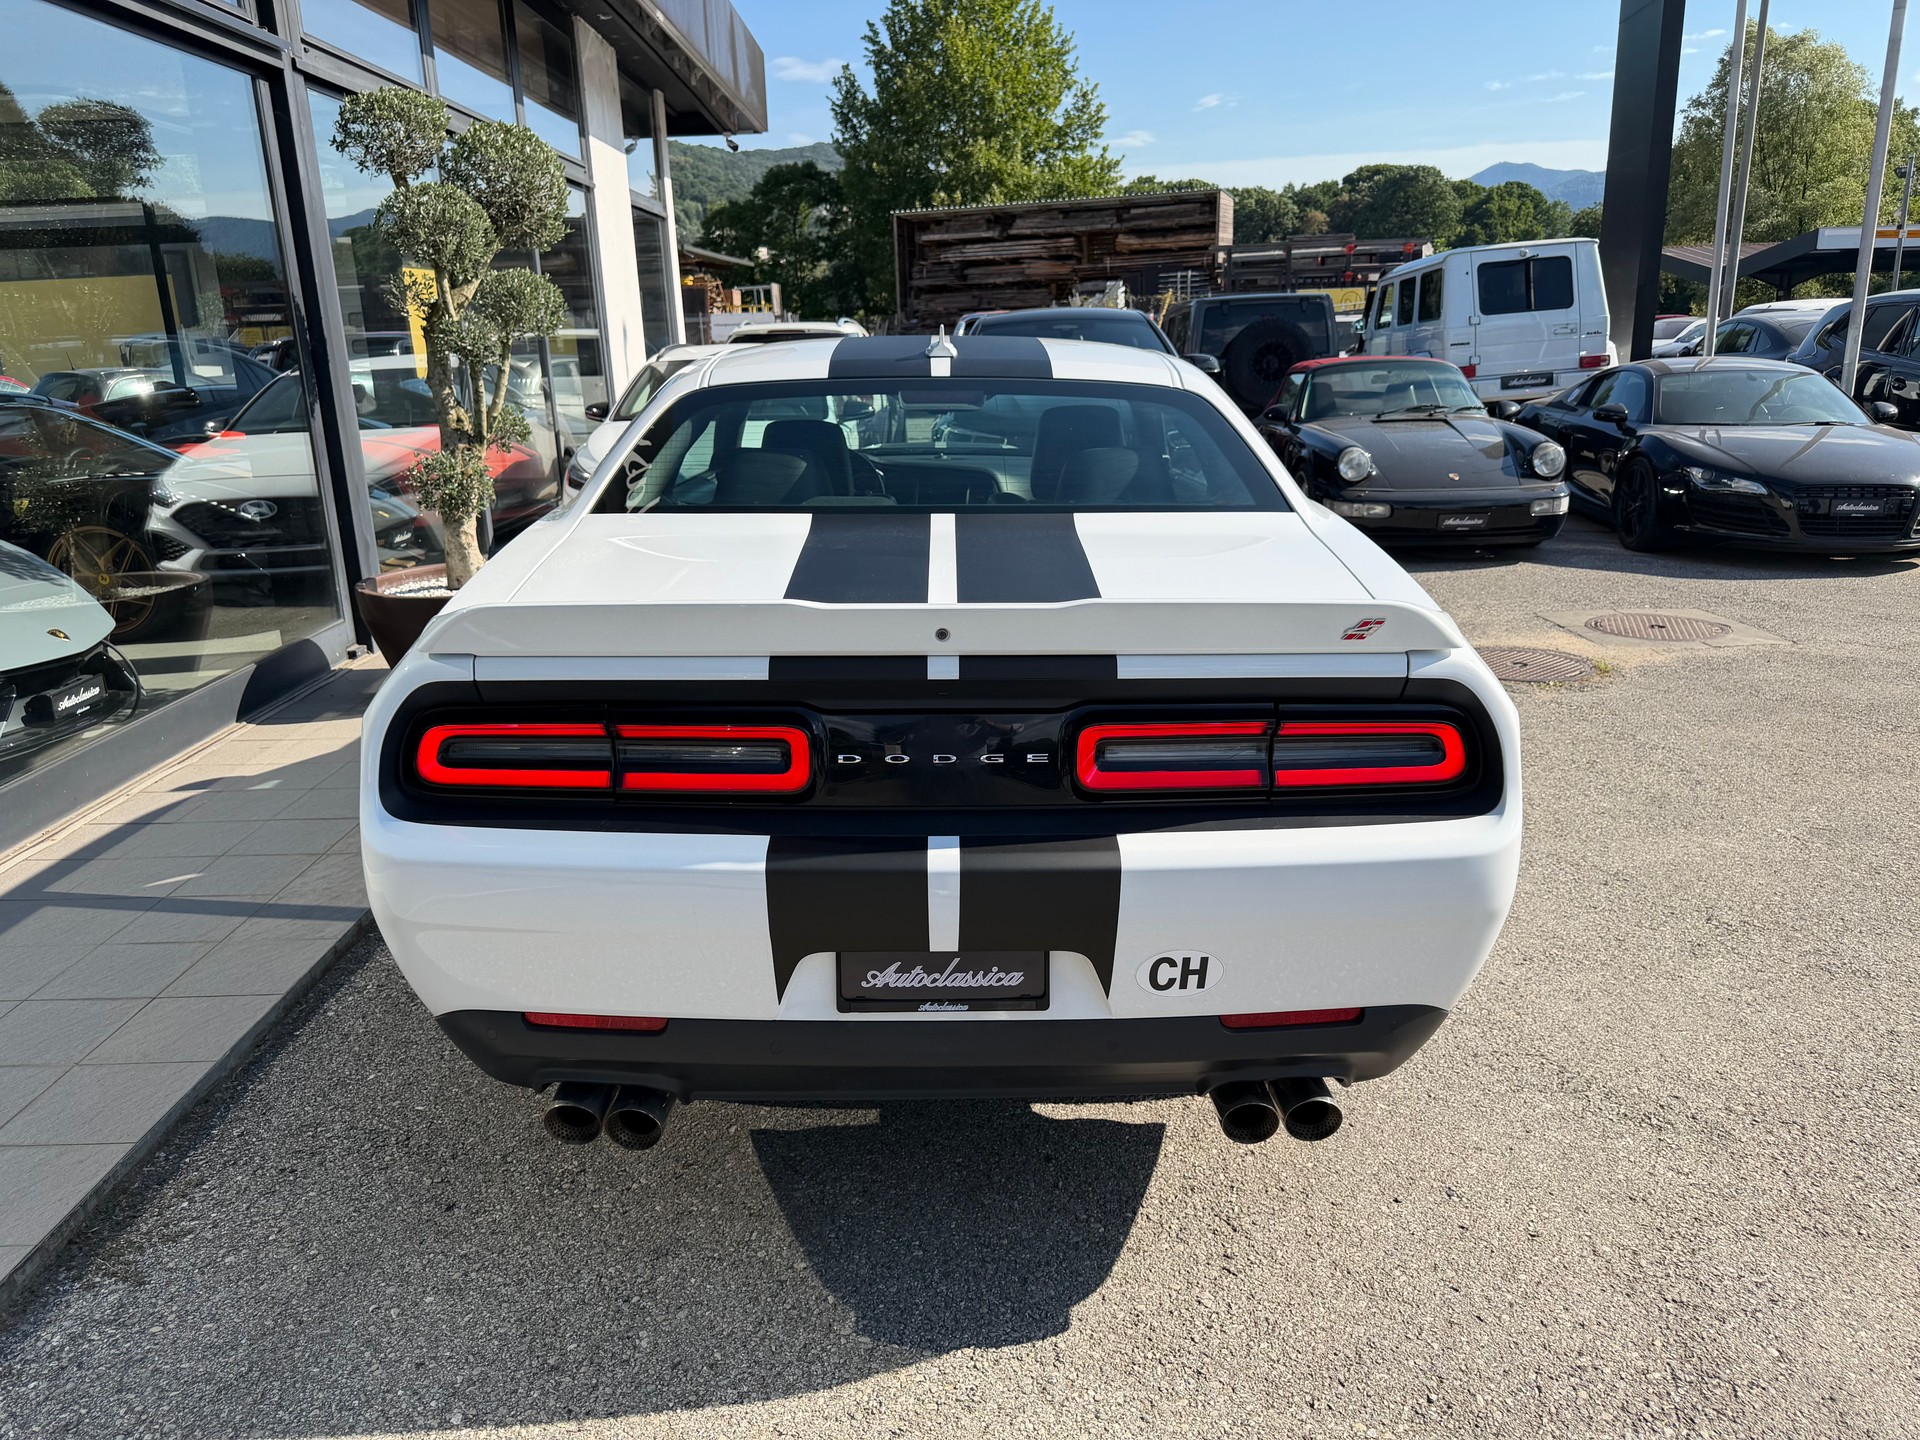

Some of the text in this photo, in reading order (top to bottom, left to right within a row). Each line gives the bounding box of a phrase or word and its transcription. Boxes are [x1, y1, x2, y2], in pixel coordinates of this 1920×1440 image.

[57, 686, 101, 711] Autoclassica
[837, 753, 1049, 764] DODGE
[861, 957, 1025, 988] Autoclassica
[1147, 955, 1210, 991] CH
[917, 1001, 969, 1012] Autoclassica
